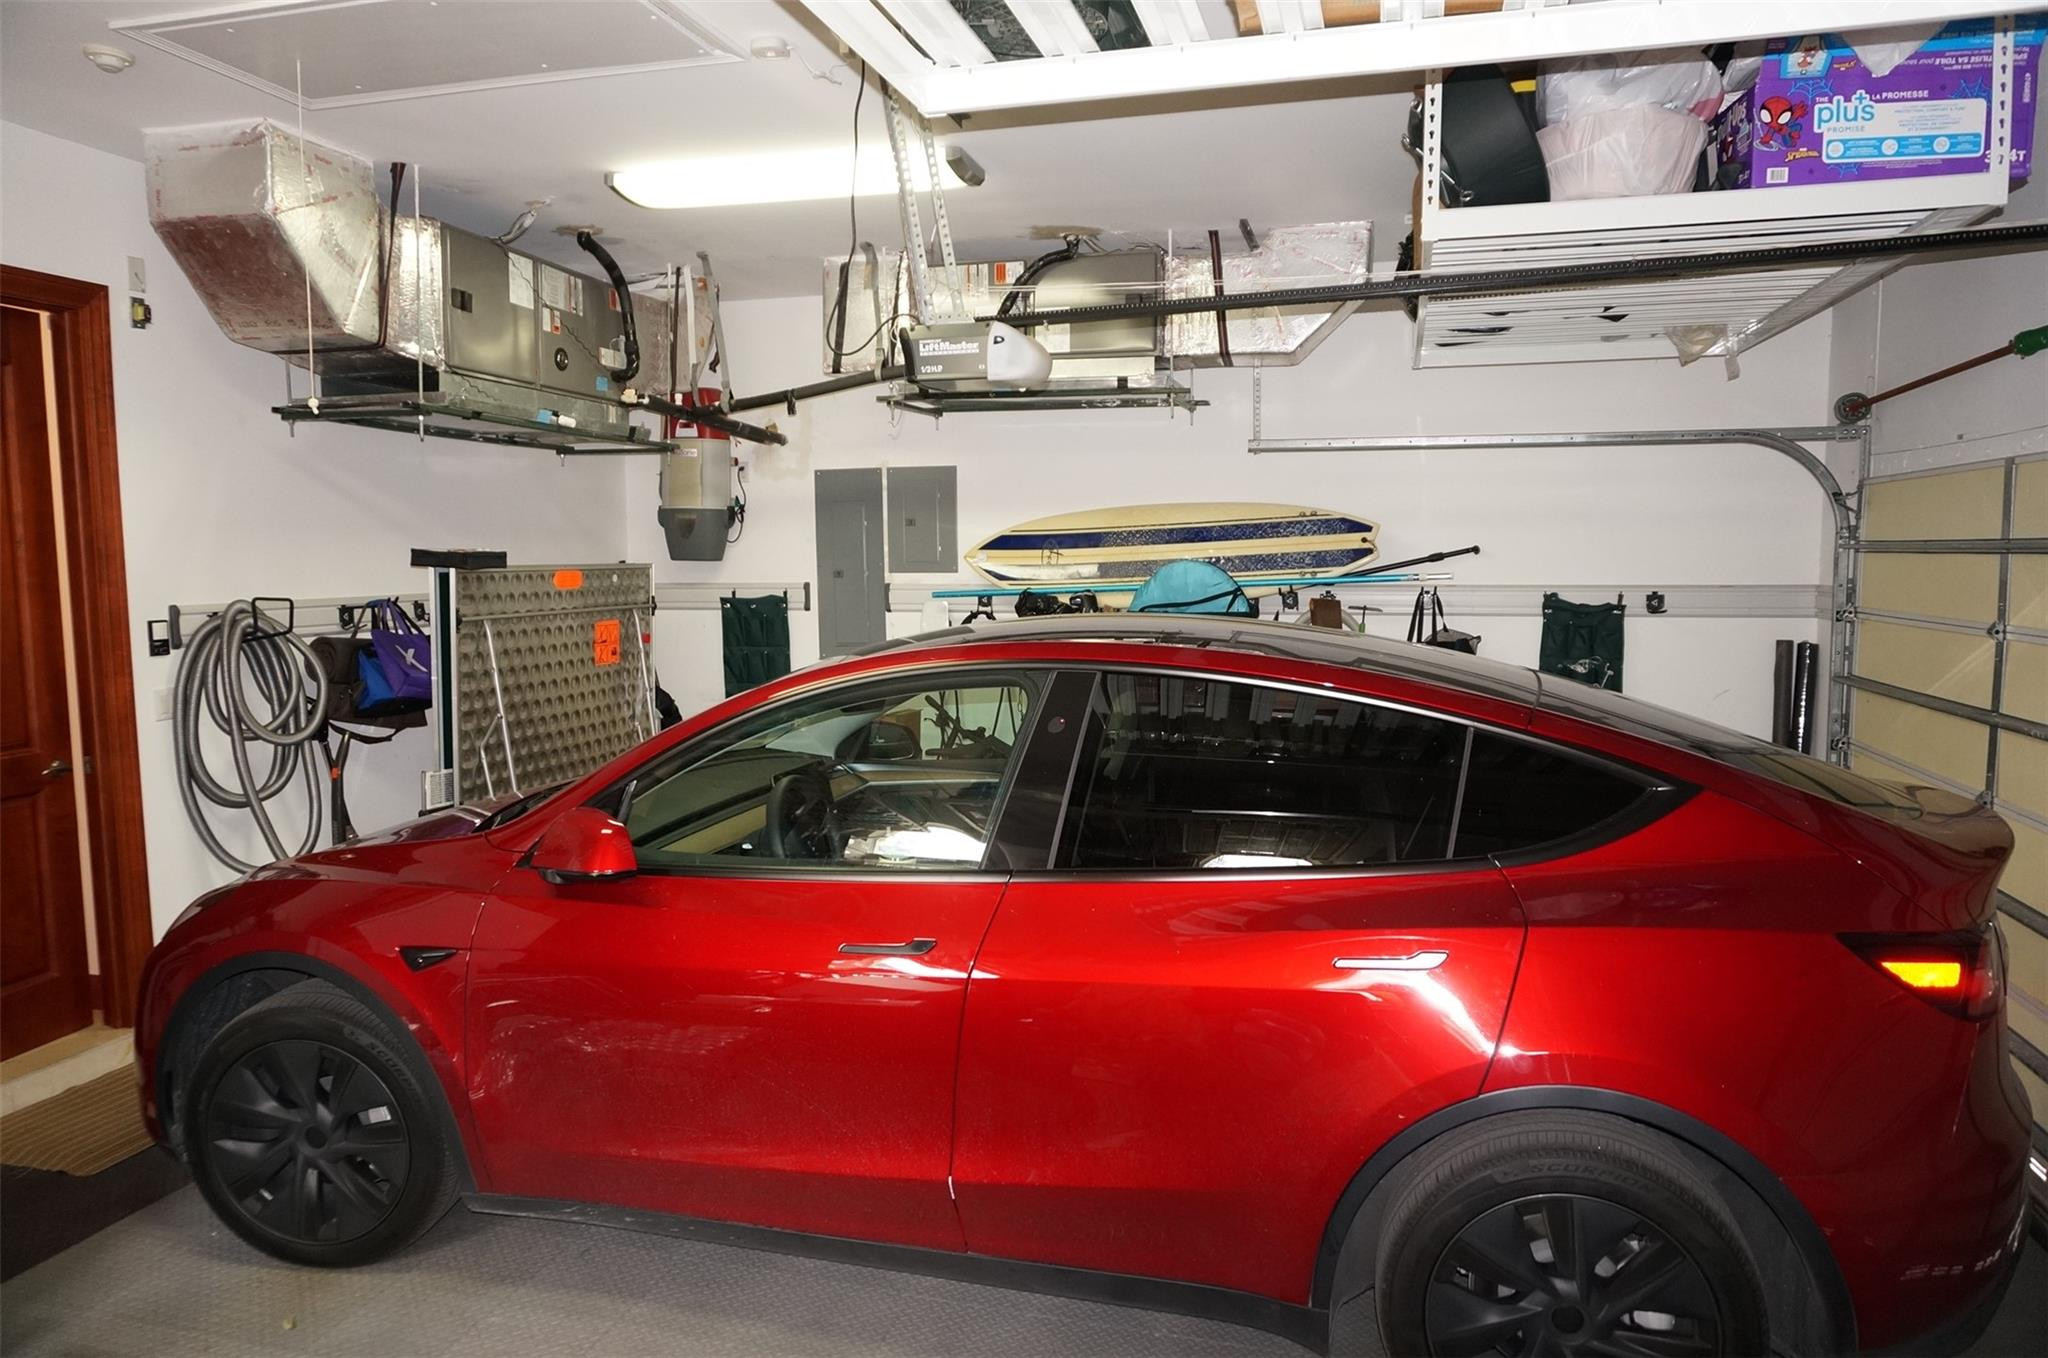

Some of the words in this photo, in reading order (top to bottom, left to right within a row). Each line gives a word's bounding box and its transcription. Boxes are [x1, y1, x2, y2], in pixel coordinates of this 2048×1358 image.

[1970, 55, 1993, 64] TILISE
[1882, 90, 1929, 99] PROMESSE
[1817, 98, 1875, 130] plus
[1984, 148, 2027, 163] 34T
[919, 341, 979, 351] LiftMaster
